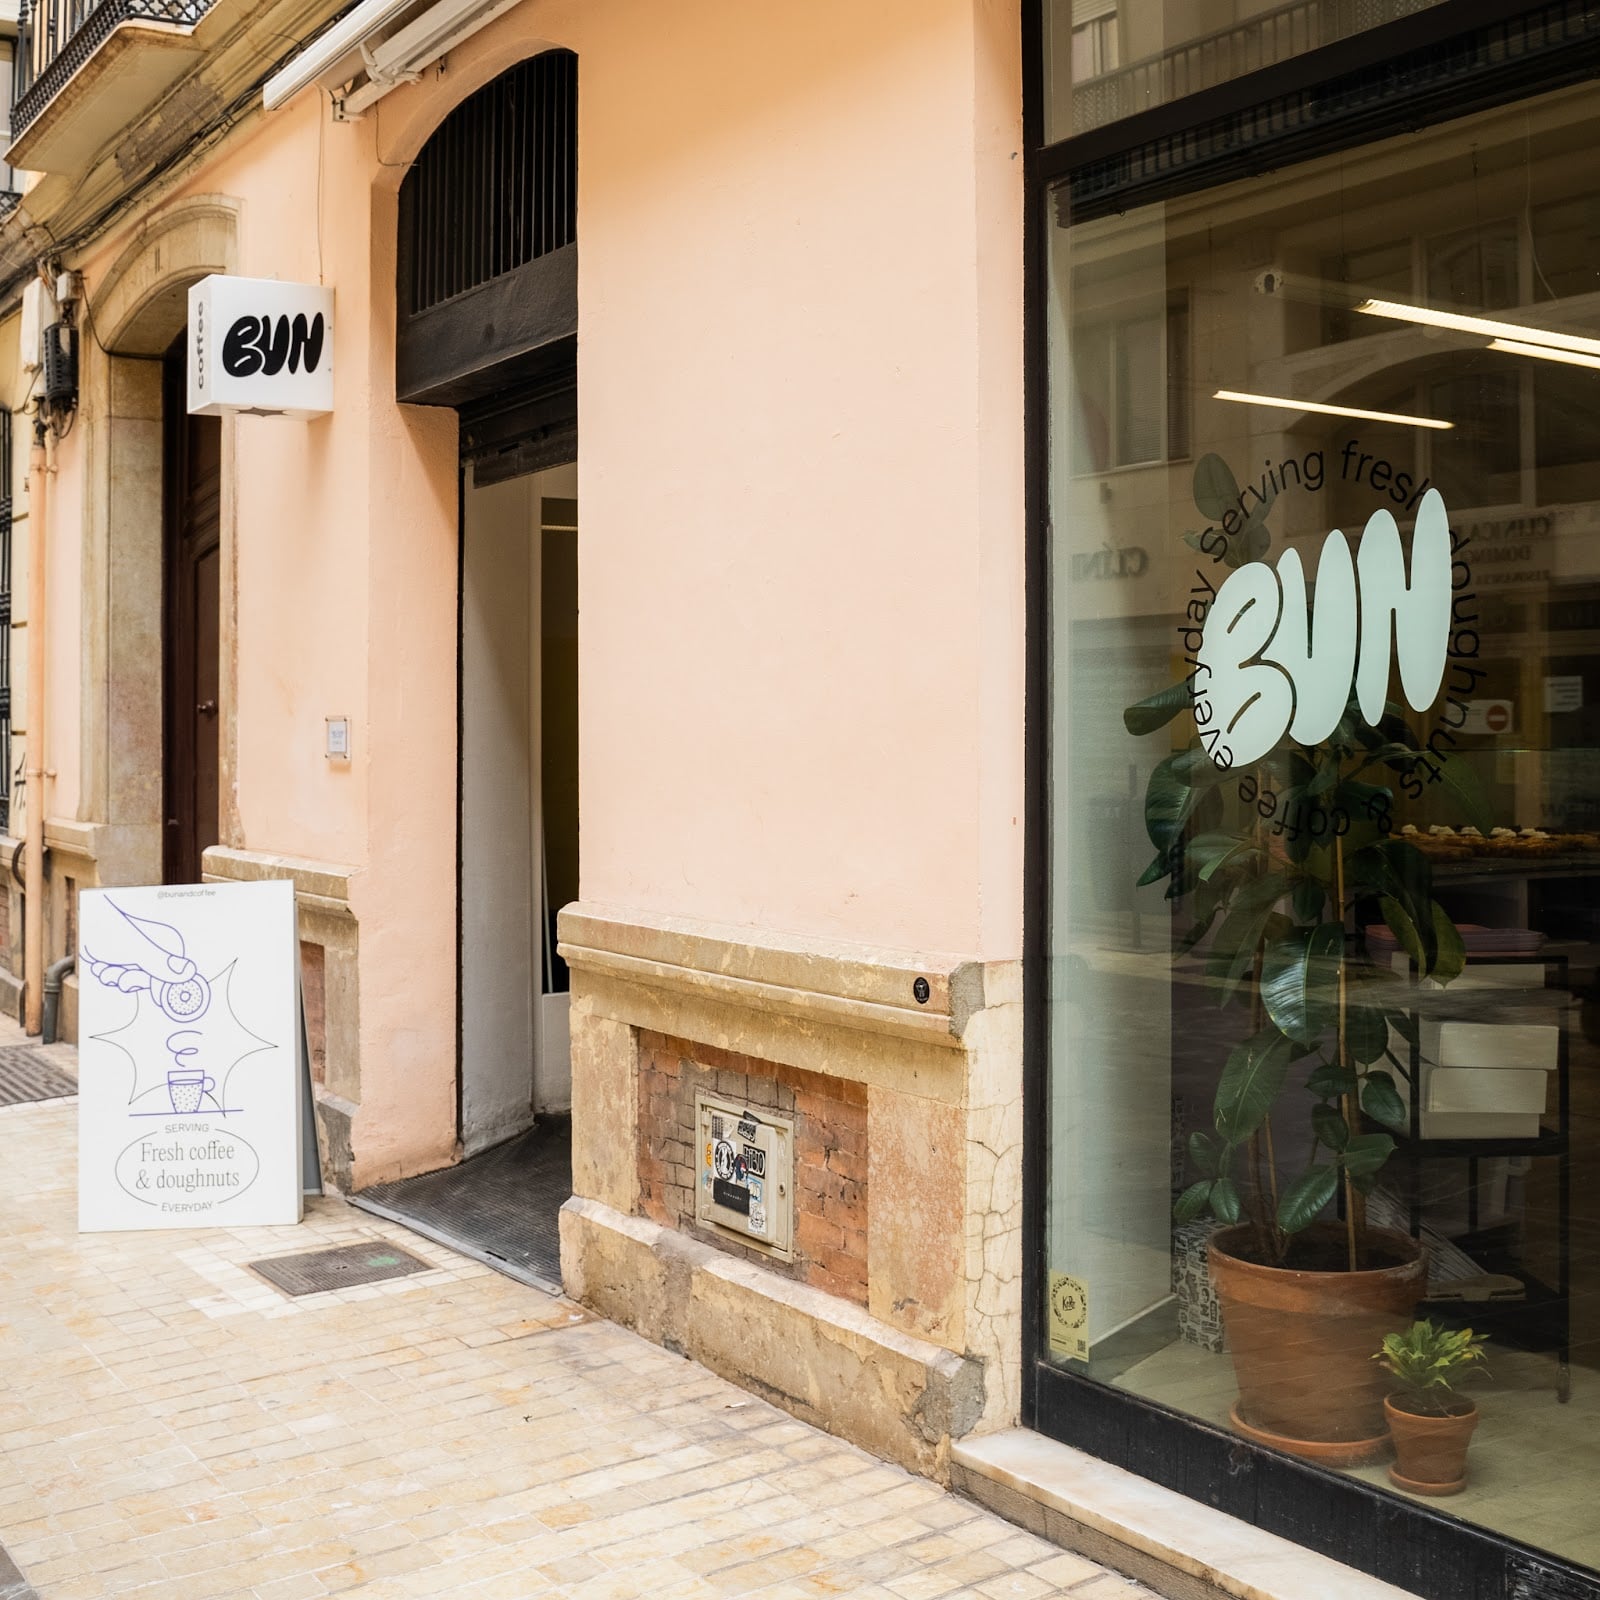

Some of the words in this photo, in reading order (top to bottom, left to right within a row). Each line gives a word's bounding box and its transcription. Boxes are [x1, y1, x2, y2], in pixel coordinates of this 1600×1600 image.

[196, 301, 204, 389] coffee
[222, 312, 324, 377] BUN
[1200, 449, 1324, 564] Serving
[1193, 488, 1453, 768] BUN
[1177, 569, 1234, 772] everyday
[1238, 775, 1350, 842] coffee
[1361, 793, 1393, 834] &
[157, 889, 217, 899] @bunandcoffee
[141, 1142, 184, 1162] Fresh
[189, 1140, 235, 1160] coffee
[165, 1123, 209, 1133] SERVING
[135, 1169, 151, 1189] &
[156, 1168, 240, 1192] doughnuts
[161, 1201, 213, 1212] EVERYDAY
